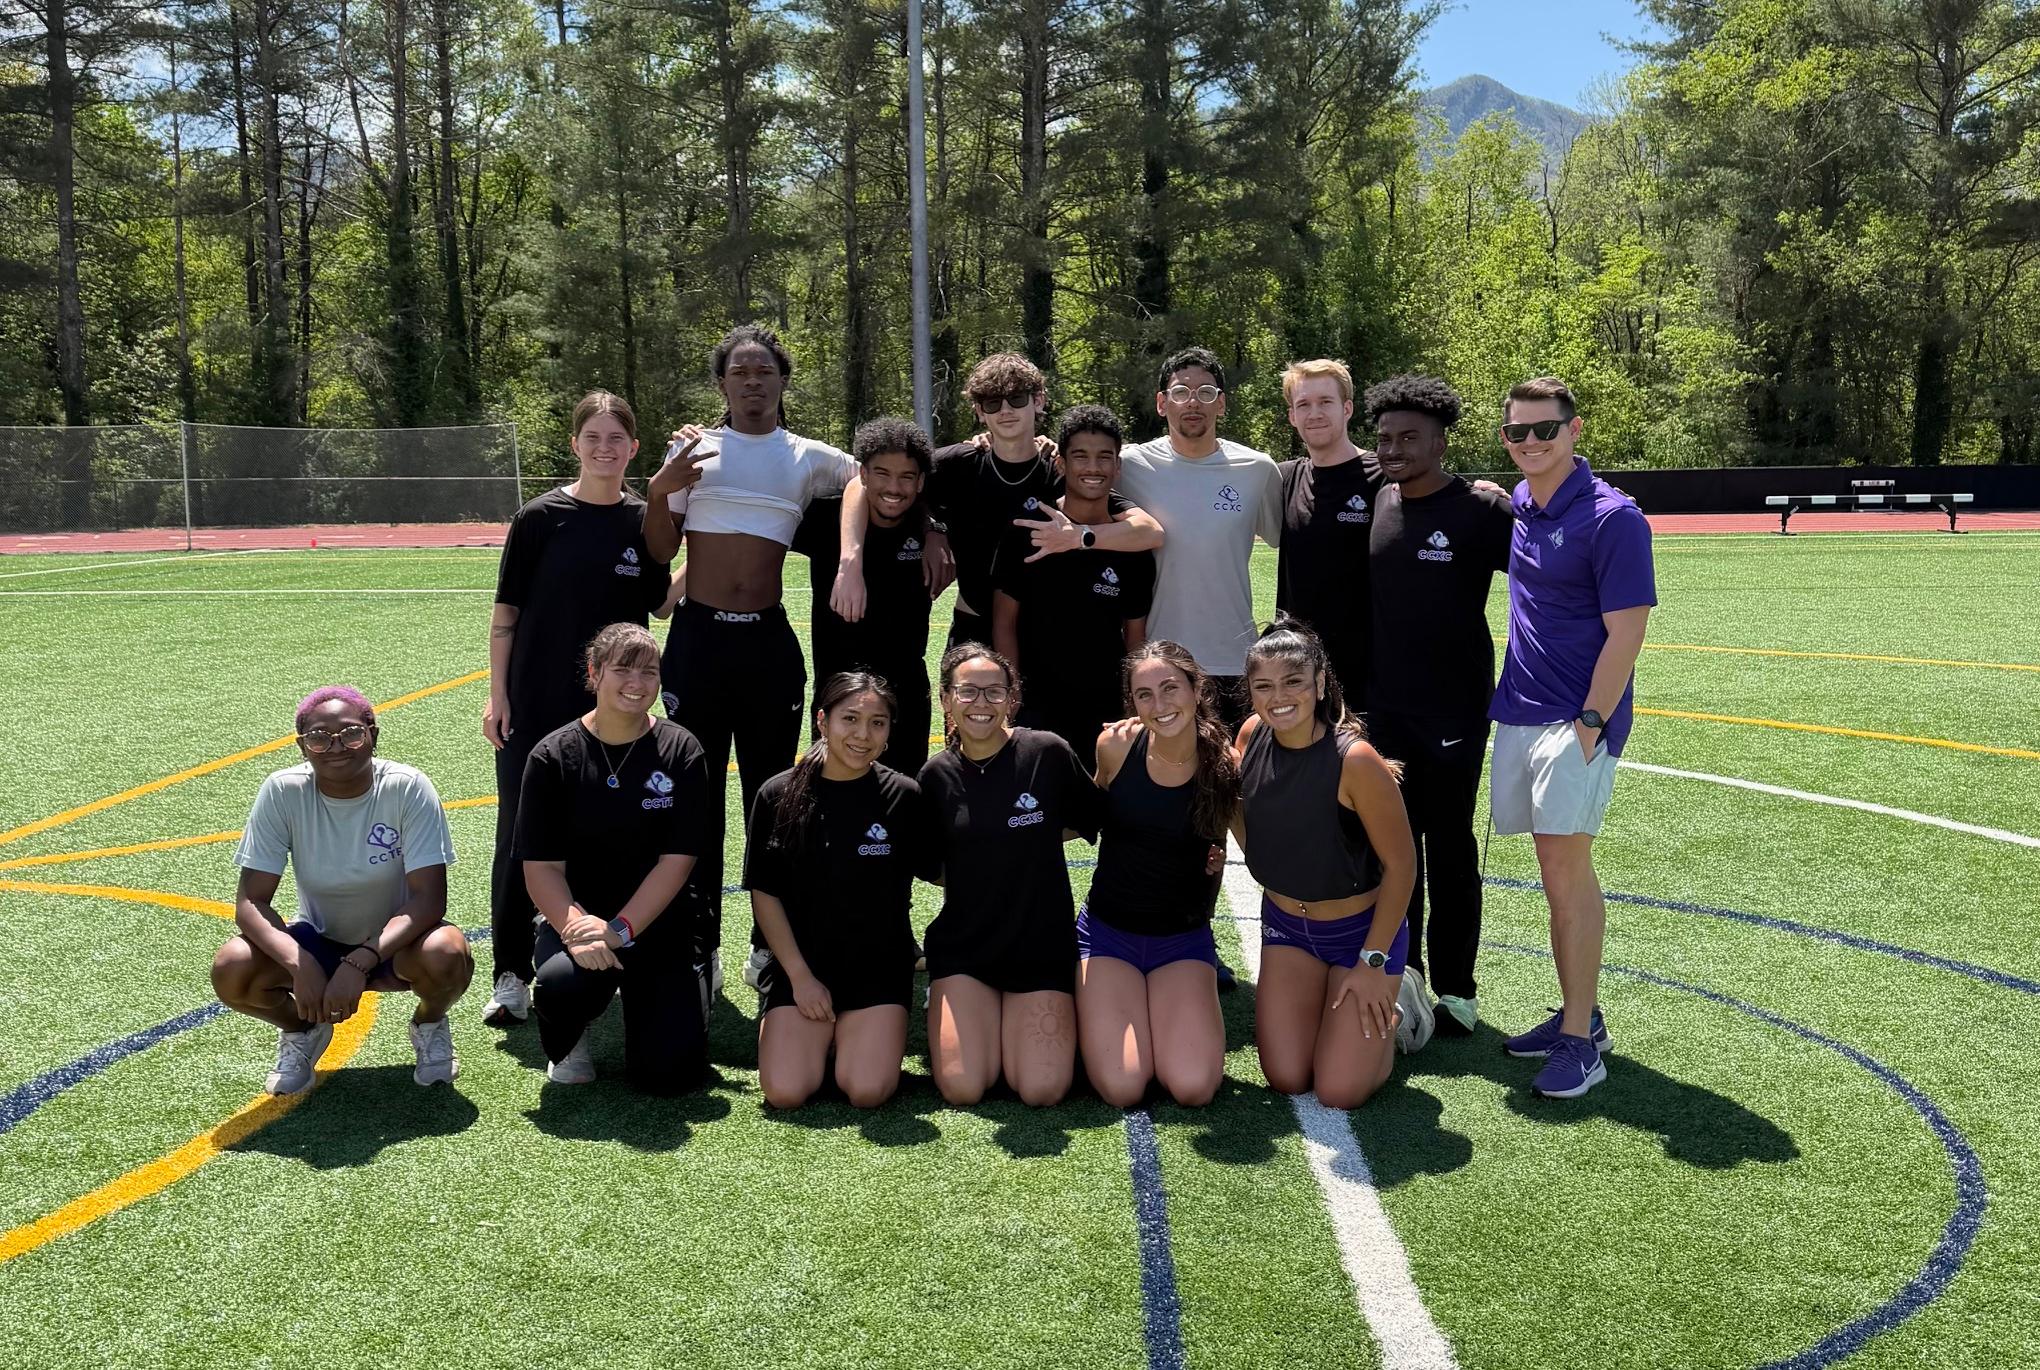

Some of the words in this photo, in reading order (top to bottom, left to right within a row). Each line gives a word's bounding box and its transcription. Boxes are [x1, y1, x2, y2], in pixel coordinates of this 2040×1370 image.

[1213, 503, 1242, 512] CCXC
[1337, 512, 1370, 522] CCXC
[1417, 550, 1453, 561] CCXC
[1008, 811, 1044, 828] CCXC
[857, 844, 891, 856] CCXC
